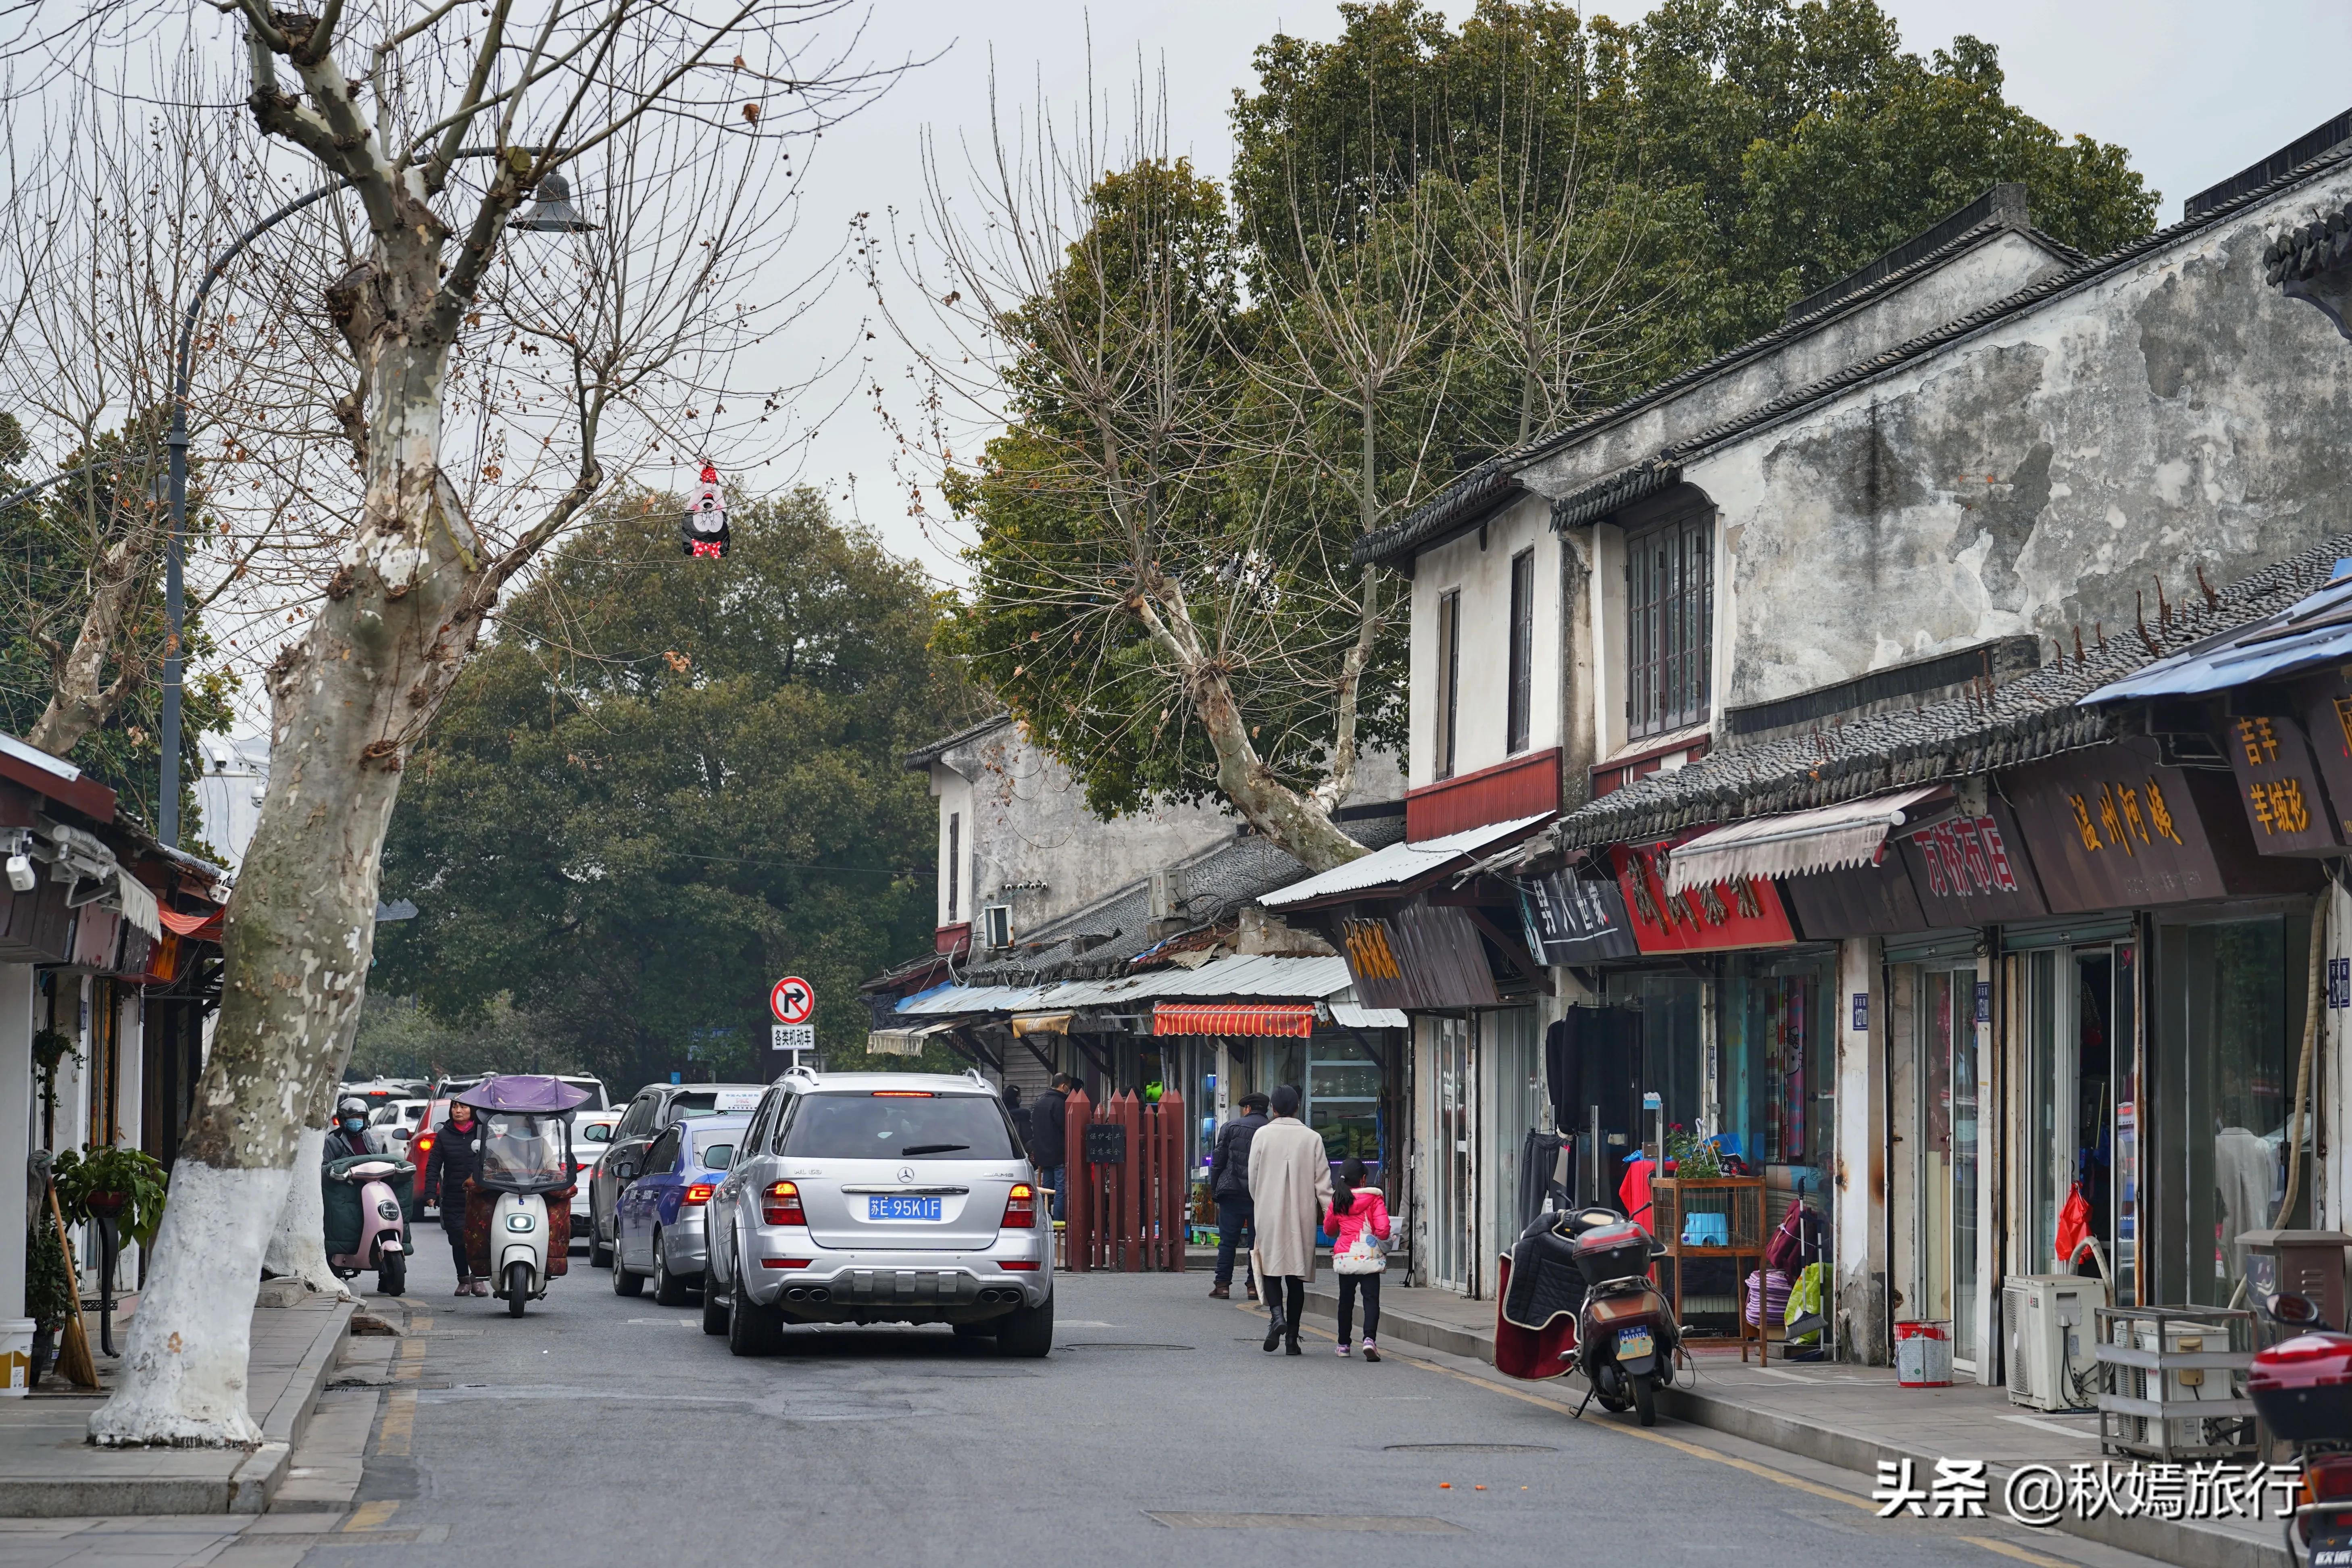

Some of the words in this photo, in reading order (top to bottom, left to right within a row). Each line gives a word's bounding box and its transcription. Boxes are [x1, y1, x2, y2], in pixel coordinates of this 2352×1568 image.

[2250, 778, 2308, 835] 羊绒衫
[1532, 871, 1609, 935] 男人世家
[775, 1029, 811, 1045] 各类机动车
[1090, 1132, 1121, 1140] 保护古井
[1621, 1332, 1646, 1341] 0411372
[2315, 1550, 2352, 1566] 欧派
